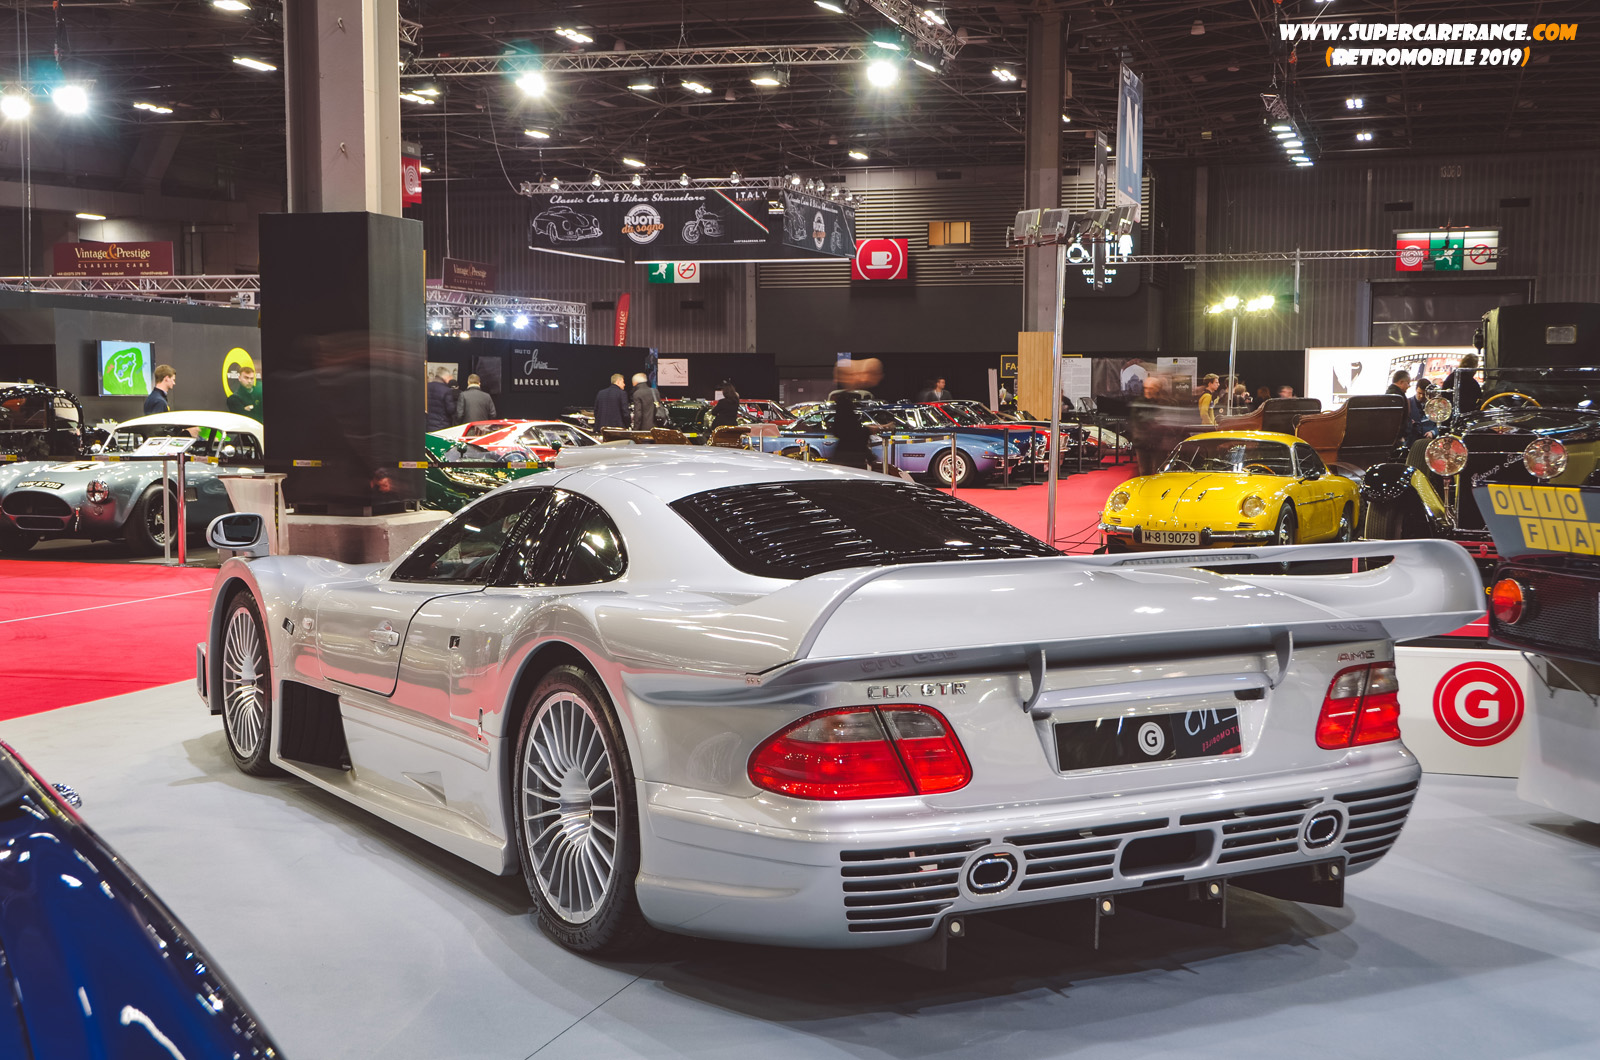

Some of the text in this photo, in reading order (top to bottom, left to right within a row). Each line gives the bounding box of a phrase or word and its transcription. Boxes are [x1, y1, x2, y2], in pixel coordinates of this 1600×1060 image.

[1125, 96, 1138, 174] N
[549, 195, 584, 204] Classic
[586, 194, 610, 203] Cars
[613, 193, 620, 203] &
[621, 193, 649, 203] Bikes
[735, 191, 768, 199] ITALY
[624, 215, 661, 225] RUOTE
[621, 223, 664, 236] da sogno
[75, 247, 107, 260] Vintage
[116, 247, 151, 260] Prestige
[1005, 362, 1018, 370] FA
[514, 378, 560, 386] BARCELONA
[1495, 490, 1579, 514] OLIO
[1337, 650, 1375, 662] AMG
[867, 682, 968, 699] CLK GTR
[1454, 681, 1499, 727] G
[1145, 730, 1158, 747] G
